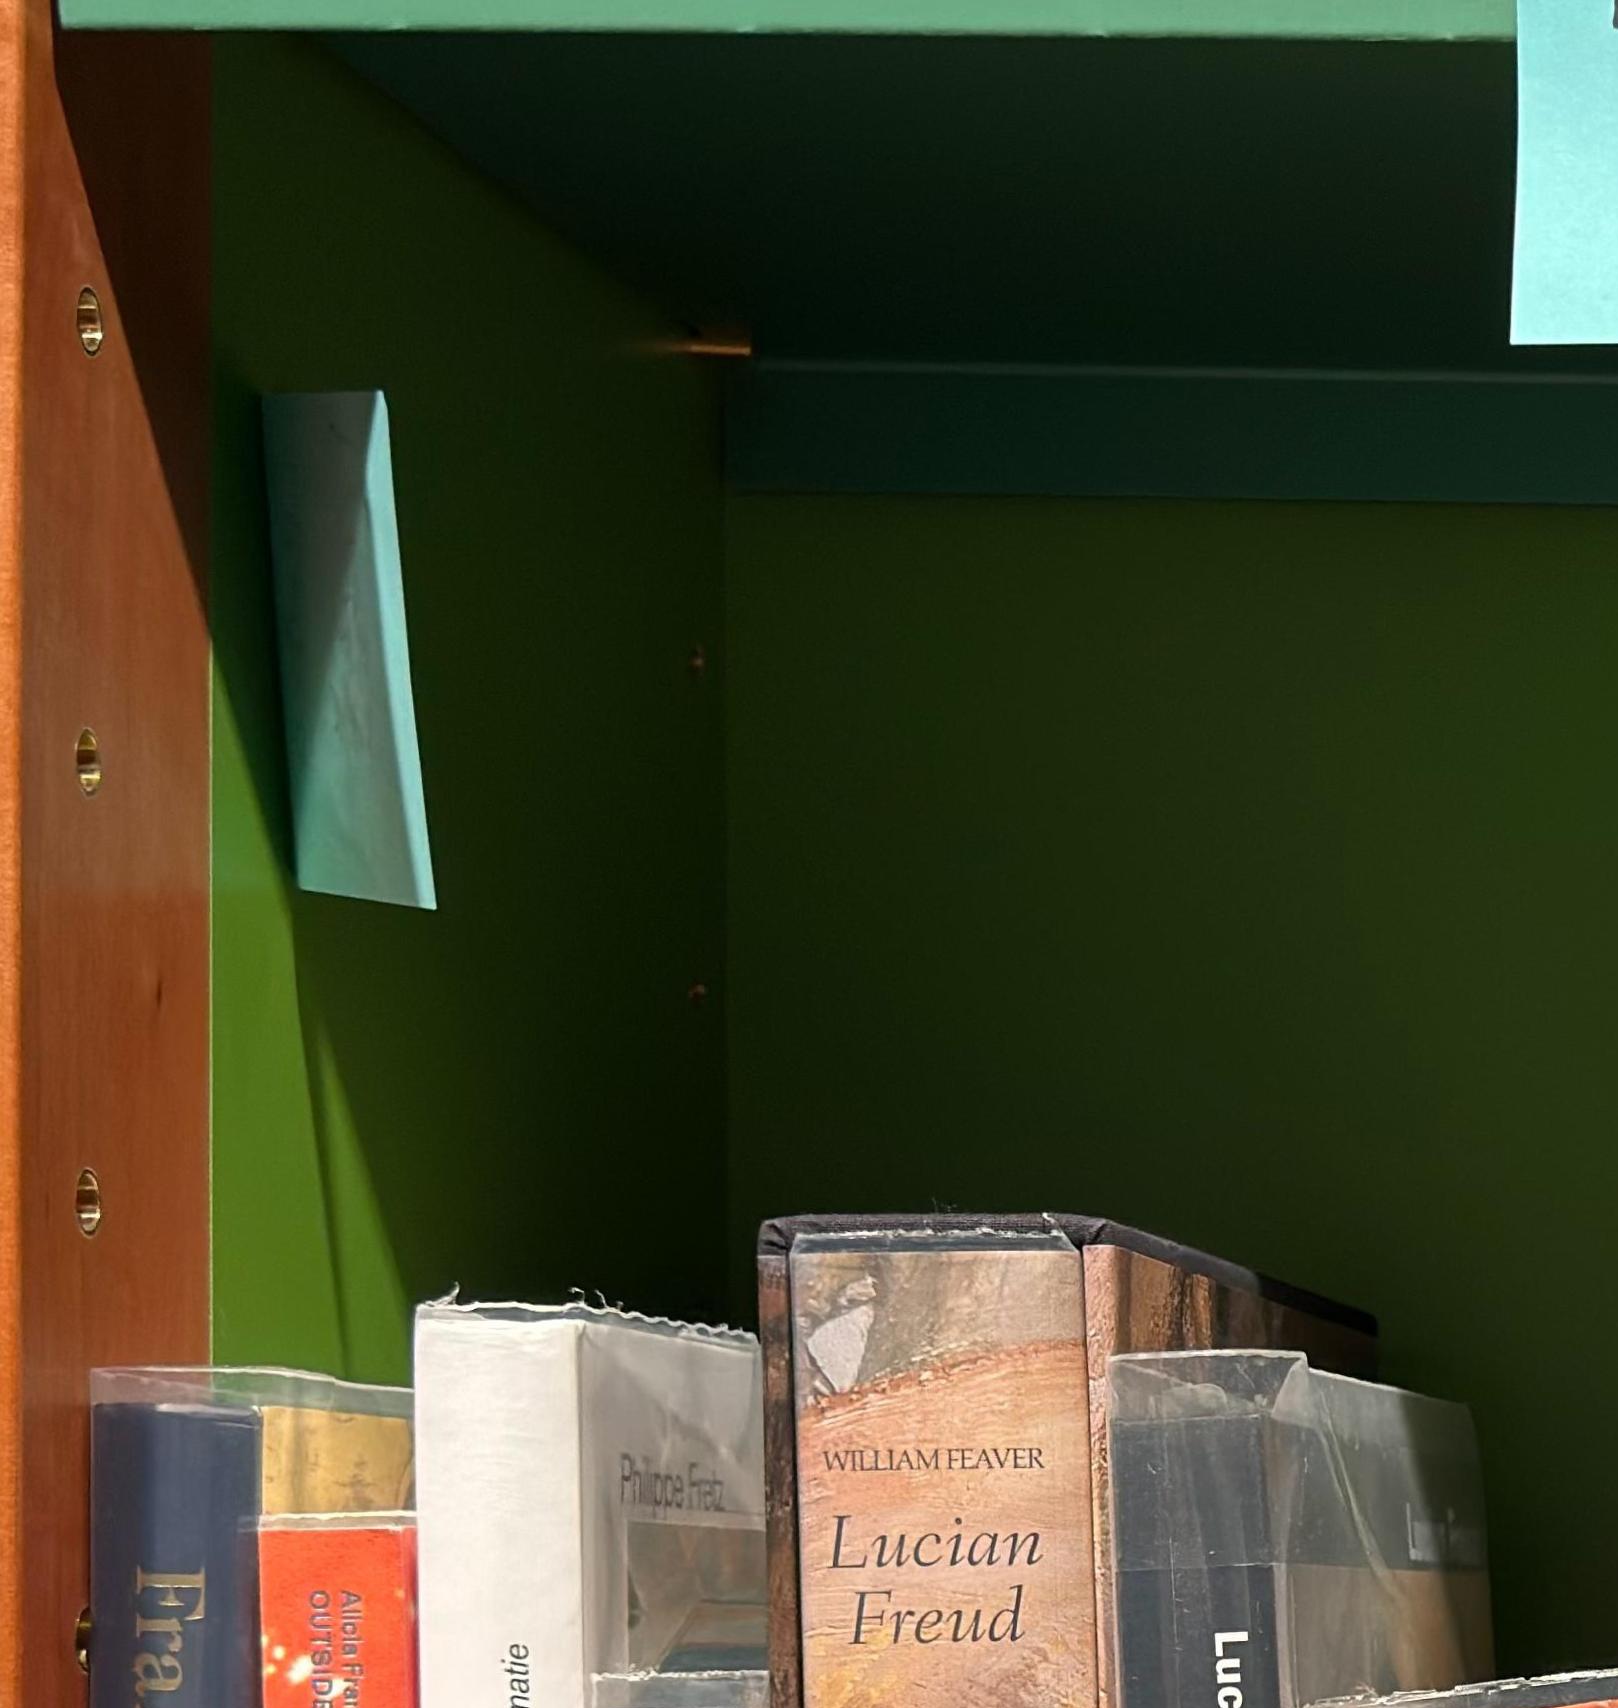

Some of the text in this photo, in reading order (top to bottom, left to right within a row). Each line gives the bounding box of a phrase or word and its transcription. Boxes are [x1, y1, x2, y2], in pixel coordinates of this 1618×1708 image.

[822, 1446, 1045, 1472] WILLIAM FEAVER
[827, 1513, 1043, 1571] Lucian
[136, 1567, 205, 1698] Fra
[341, 1590, 364, 1660] Alicia
[848, 1583, 1027, 1647] Freud
